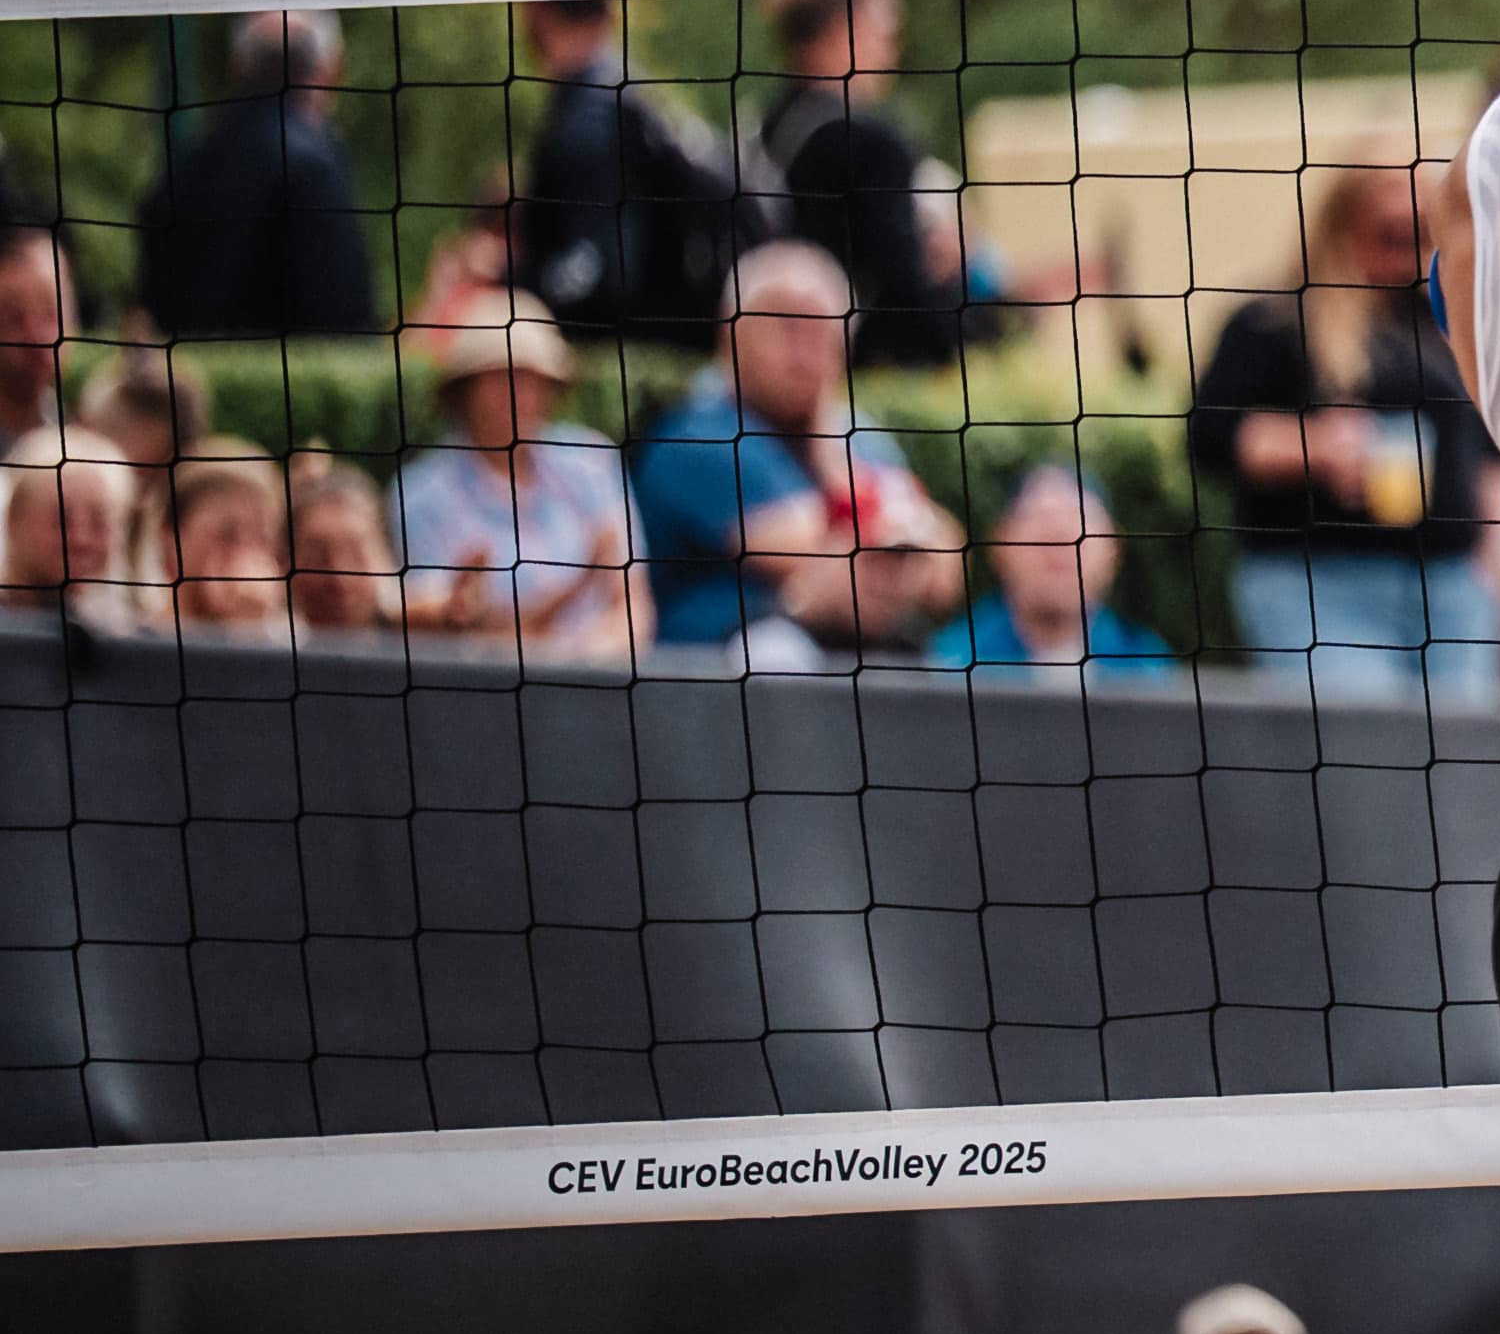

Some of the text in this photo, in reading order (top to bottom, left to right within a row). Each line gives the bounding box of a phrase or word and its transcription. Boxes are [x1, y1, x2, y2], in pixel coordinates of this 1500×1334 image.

[547, 1140, 1047, 1195] CEV EuroBeachVolley 2025
